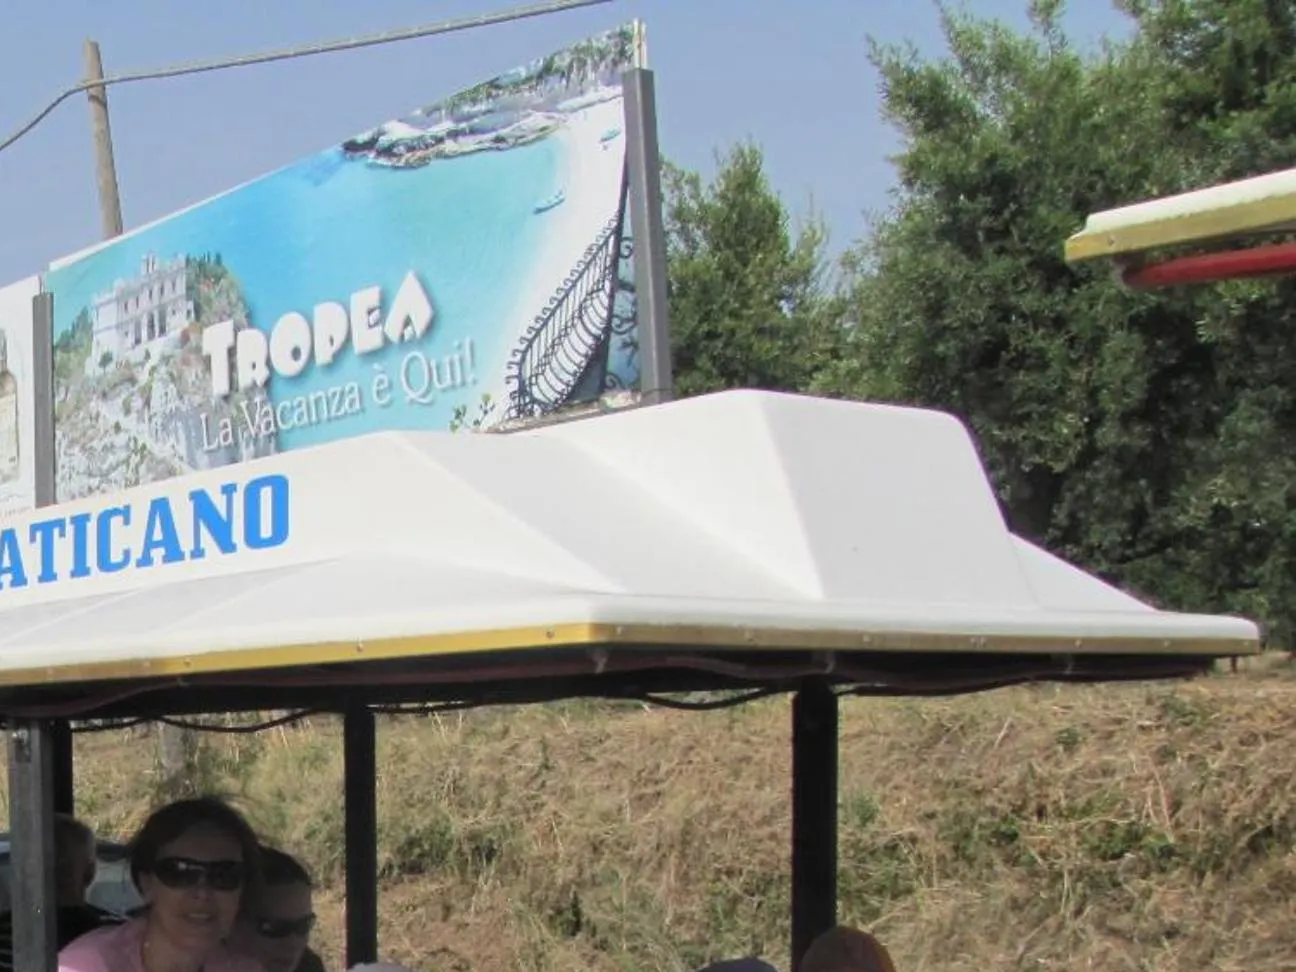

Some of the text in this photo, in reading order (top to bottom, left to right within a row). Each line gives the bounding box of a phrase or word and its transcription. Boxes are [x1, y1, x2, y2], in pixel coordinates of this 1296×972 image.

[200, 336, 476, 450] La Vacanza è Qui!
[202, 270, 434, 398] TROPEA
